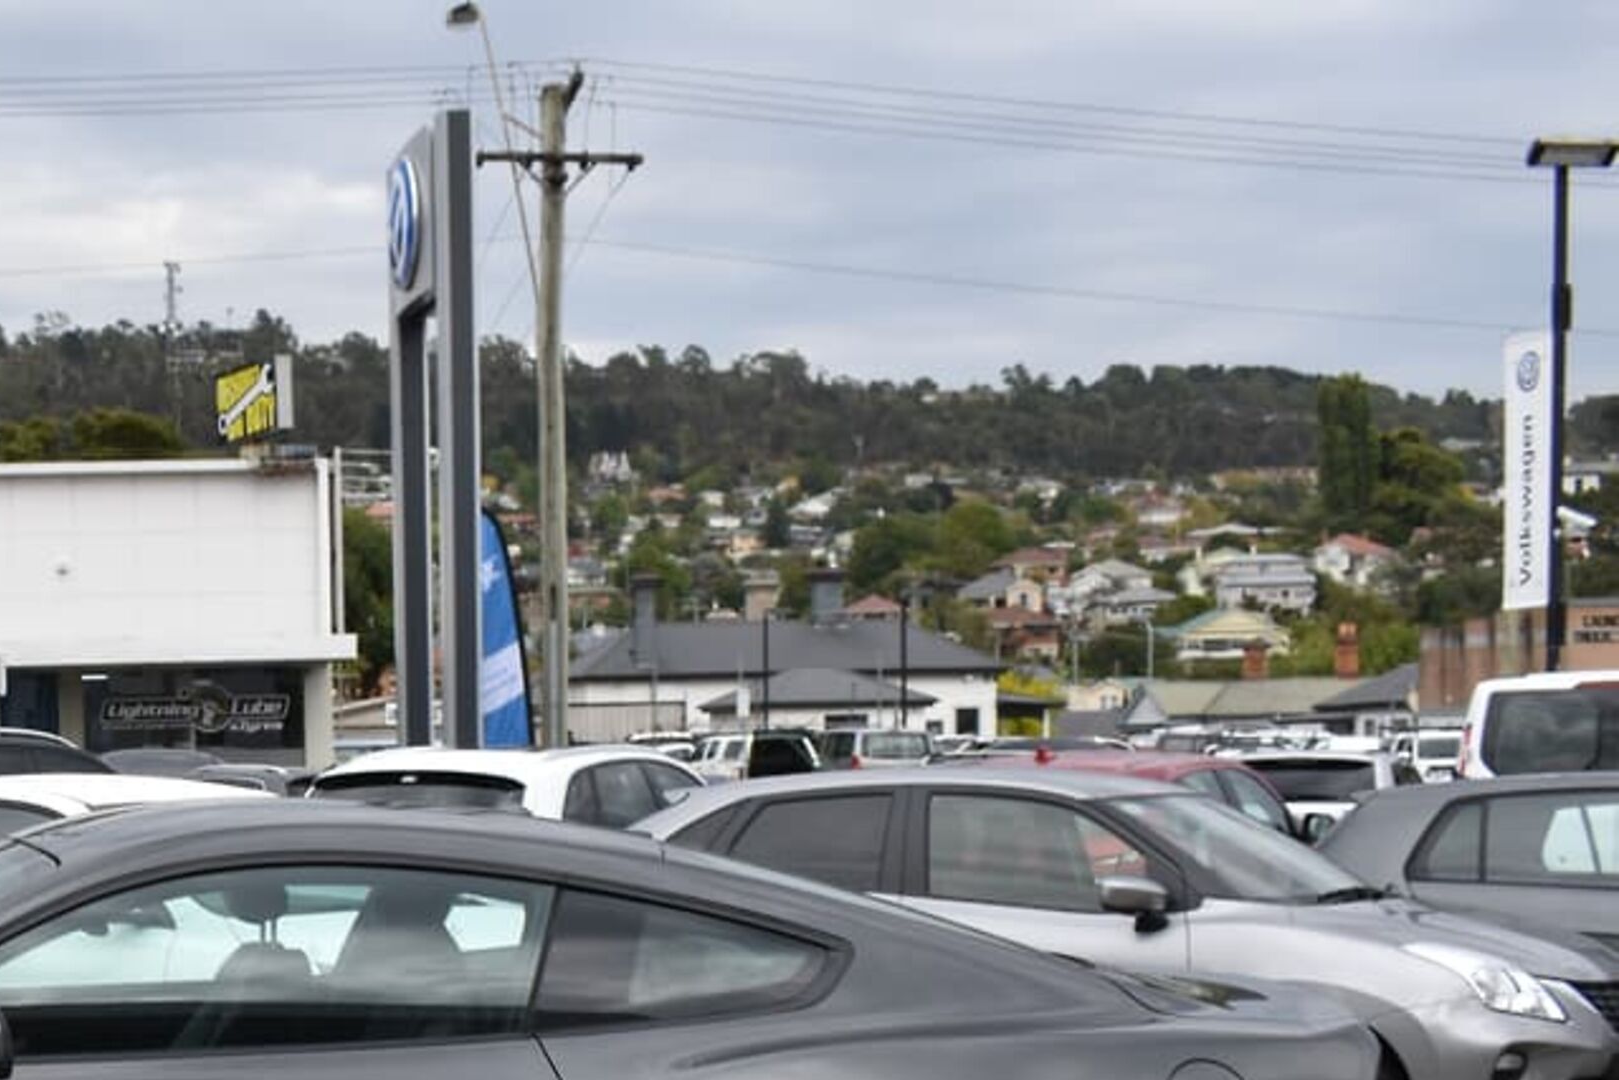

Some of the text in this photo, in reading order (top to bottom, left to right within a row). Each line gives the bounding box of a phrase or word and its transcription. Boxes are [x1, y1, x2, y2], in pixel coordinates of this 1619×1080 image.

[1518, 414, 1535, 586] Volkswagen
[106, 699, 283, 724] Lightning Lube
